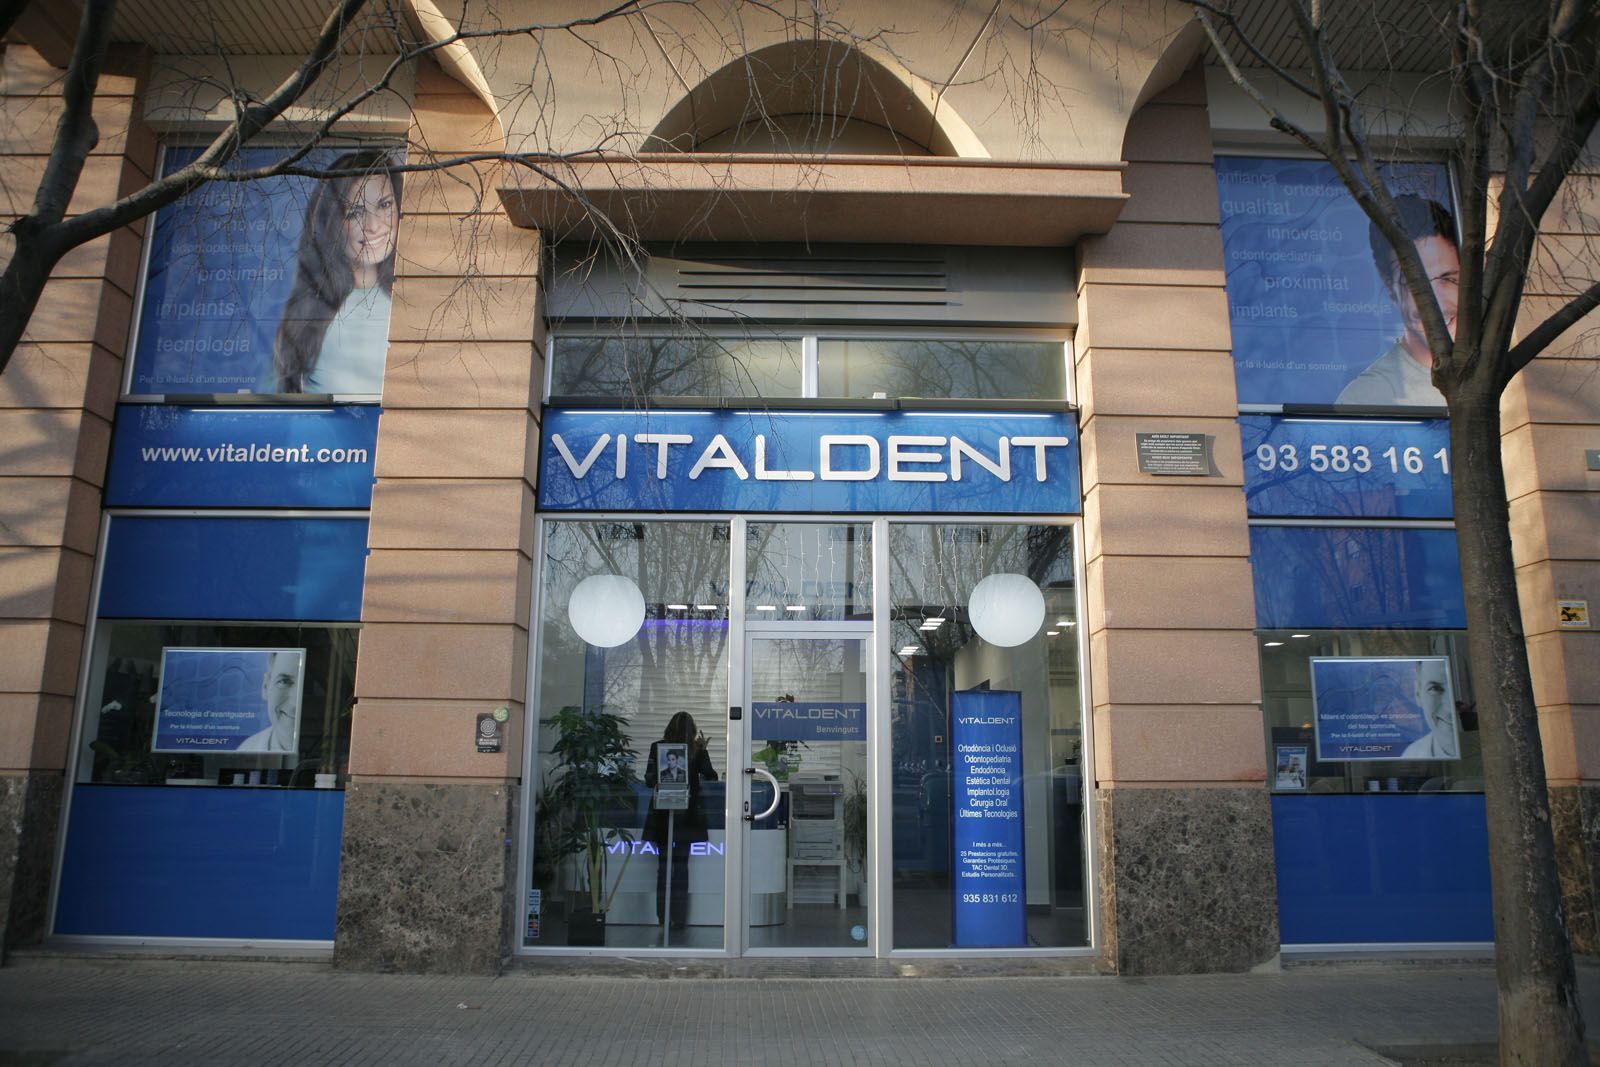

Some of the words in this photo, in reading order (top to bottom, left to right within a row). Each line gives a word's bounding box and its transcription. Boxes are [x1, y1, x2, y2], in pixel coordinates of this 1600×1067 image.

[1216, 172, 1277, 188] onfiança
[1283, 184, 1346, 199] ortodon
[1222, 198, 1290, 217] qualitat
[1267, 226, 1344, 242] innovació
[1231, 249, 1322, 263] odontopediatria
[197, 265, 284, 284] proximitat
[1264, 273, 1350, 292] proximitat
[156, 299, 235, 320] implants
[1231, 303, 1298, 320] implants
[1246, 359, 1254, 368] la
[1286, 360, 1306, 370] d'un
[156, 375, 164, 383] la
[196, 375, 216, 383] d'un
[217, 376, 256, 384] somriure
[141, 443, 368, 463] www.vitaldent.com
[551, 433, 1069, 482] VITALDENT
[1256, 444, 1299, 471] 93
[1310, 445, 1372, 473] 583
[1382, 446, 1424, 474] 16
[1433, 447, 1449, 474] 1
[164, 709, 202, 719] Tecnologia
[204, 710, 256, 720] d'avantguarda
[755, 708, 860, 719] VITALDENT
[816, 725, 859, 734] Benvinguts
[176, 737, 229, 745] VITALDENT
[958, 744, 991, 753] Ortodòncia
[995, 744, 1016, 753] Oclusió
[964, 755, 1012, 765] Odontopediatria
[971, 765, 1006, 774] Endodòncia
[991, 776, 1010, 785] Dental
[970, 798, 994, 808] Cirurgia
[995, 798, 1008, 806] Oral
[959, 808, 982, 818] Últimes
[984, 810, 1018, 820] Tecnologies
[963, 894, 980, 903] 935
[982, 894, 999, 903] 831
[1001, 894, 1018, 903] 612
